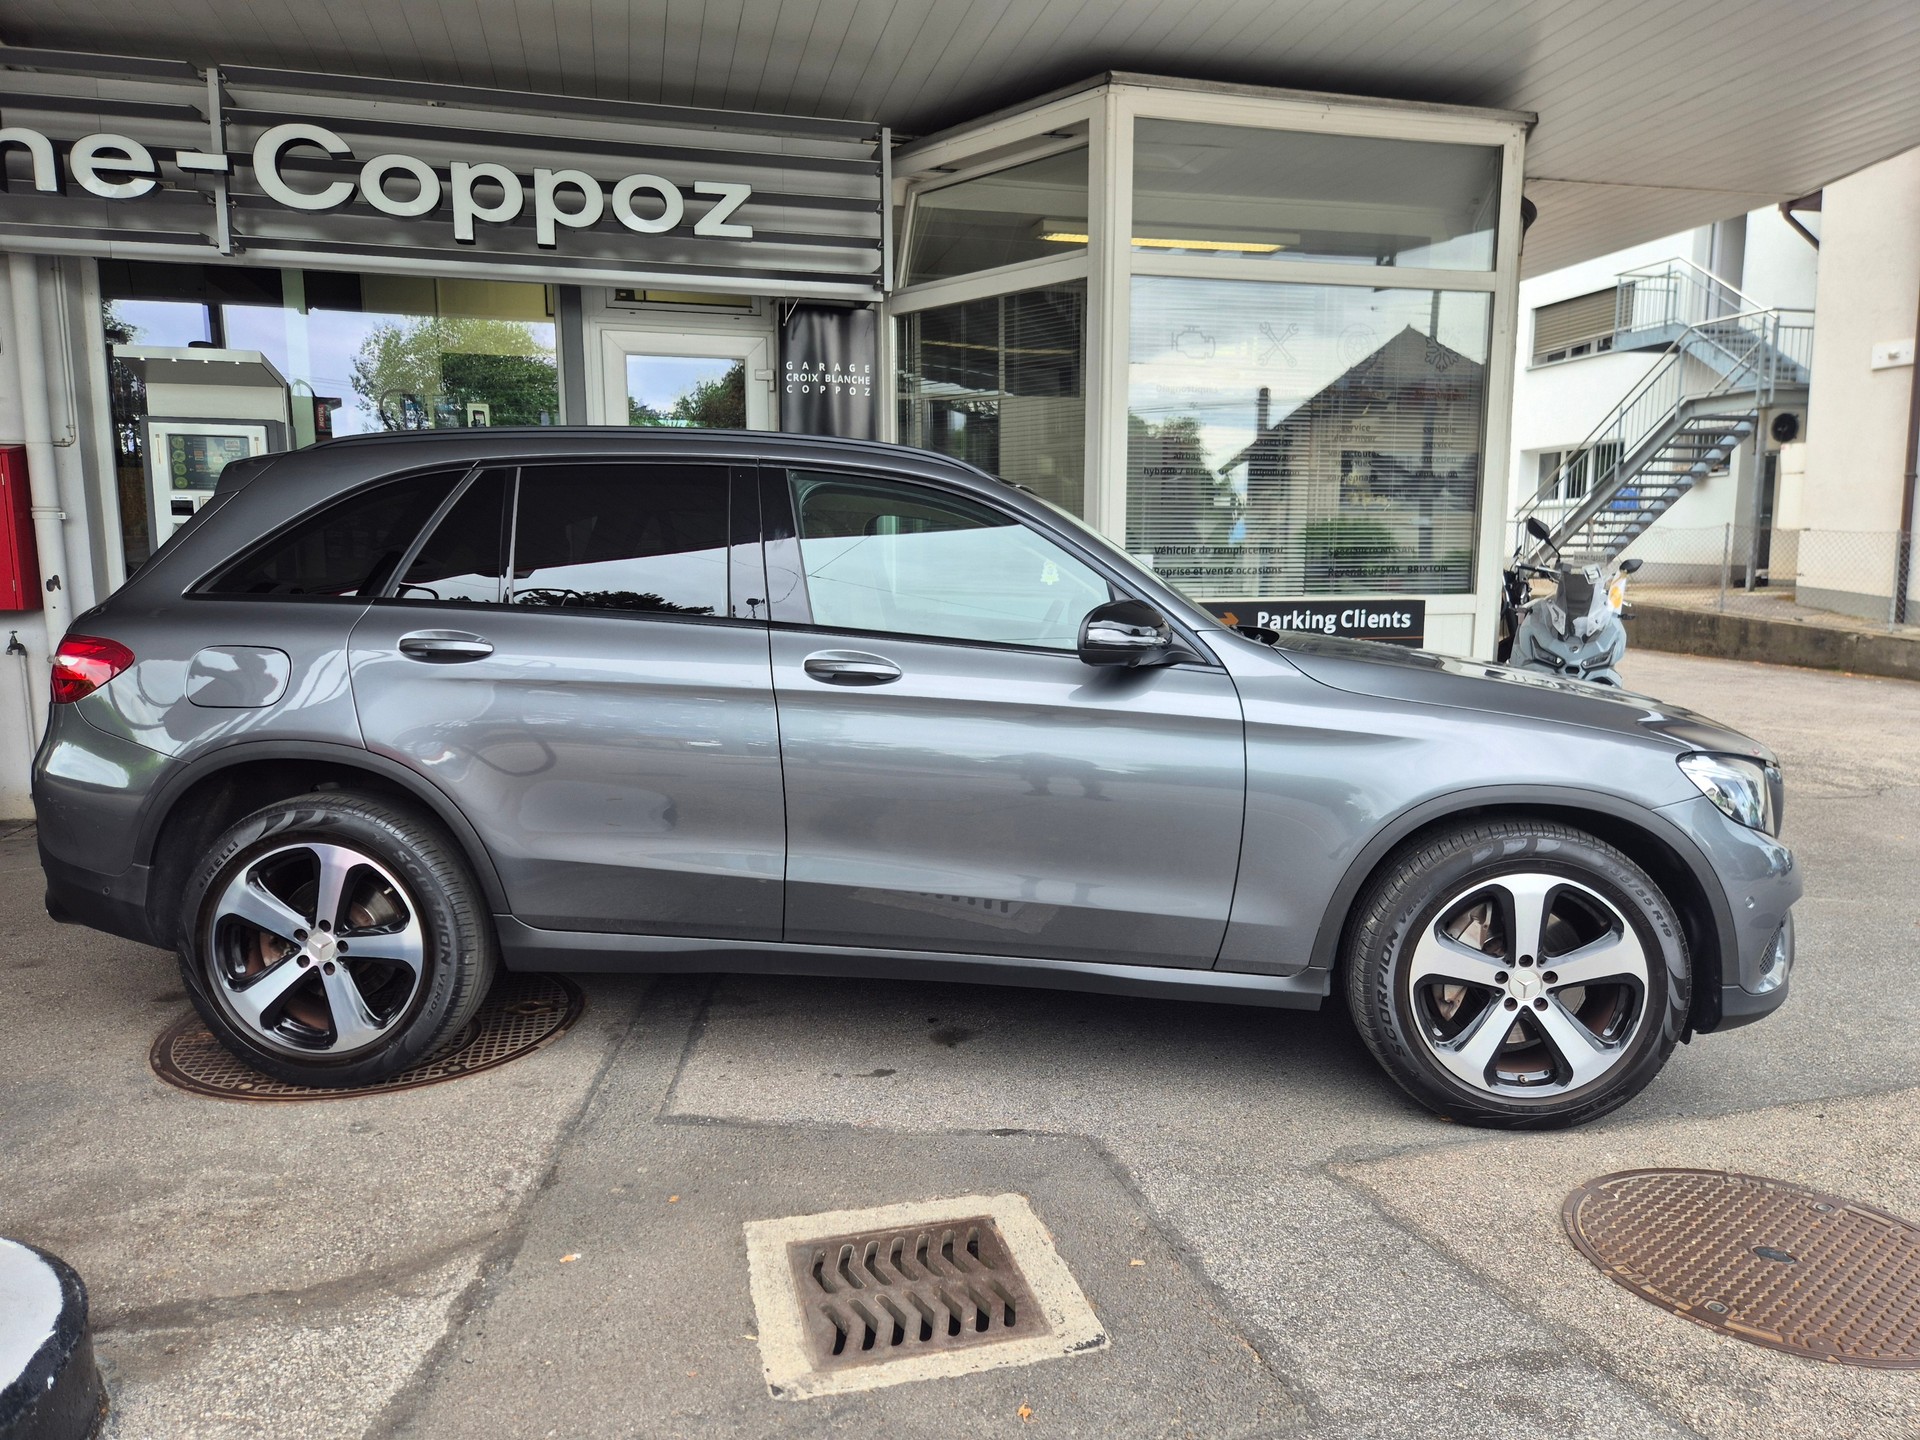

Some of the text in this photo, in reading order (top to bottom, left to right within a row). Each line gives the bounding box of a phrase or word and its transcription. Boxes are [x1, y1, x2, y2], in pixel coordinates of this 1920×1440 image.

[785, 361, 870, 373] GARAGE
[785, 373, 871, 385] CROIX BLANCHE
[786, 385, 871, 396] COPPOZ
[1154, 545, 1284, 556] Véhicule de remplacement
[1154, 566, 1283, 578] Reprise et vente occasions
[1256, 609, 1412, 634] Parking Clients
[1652, 909, 1673, 939] R19
[1376, 928, 1407, 1058] SCORPION
